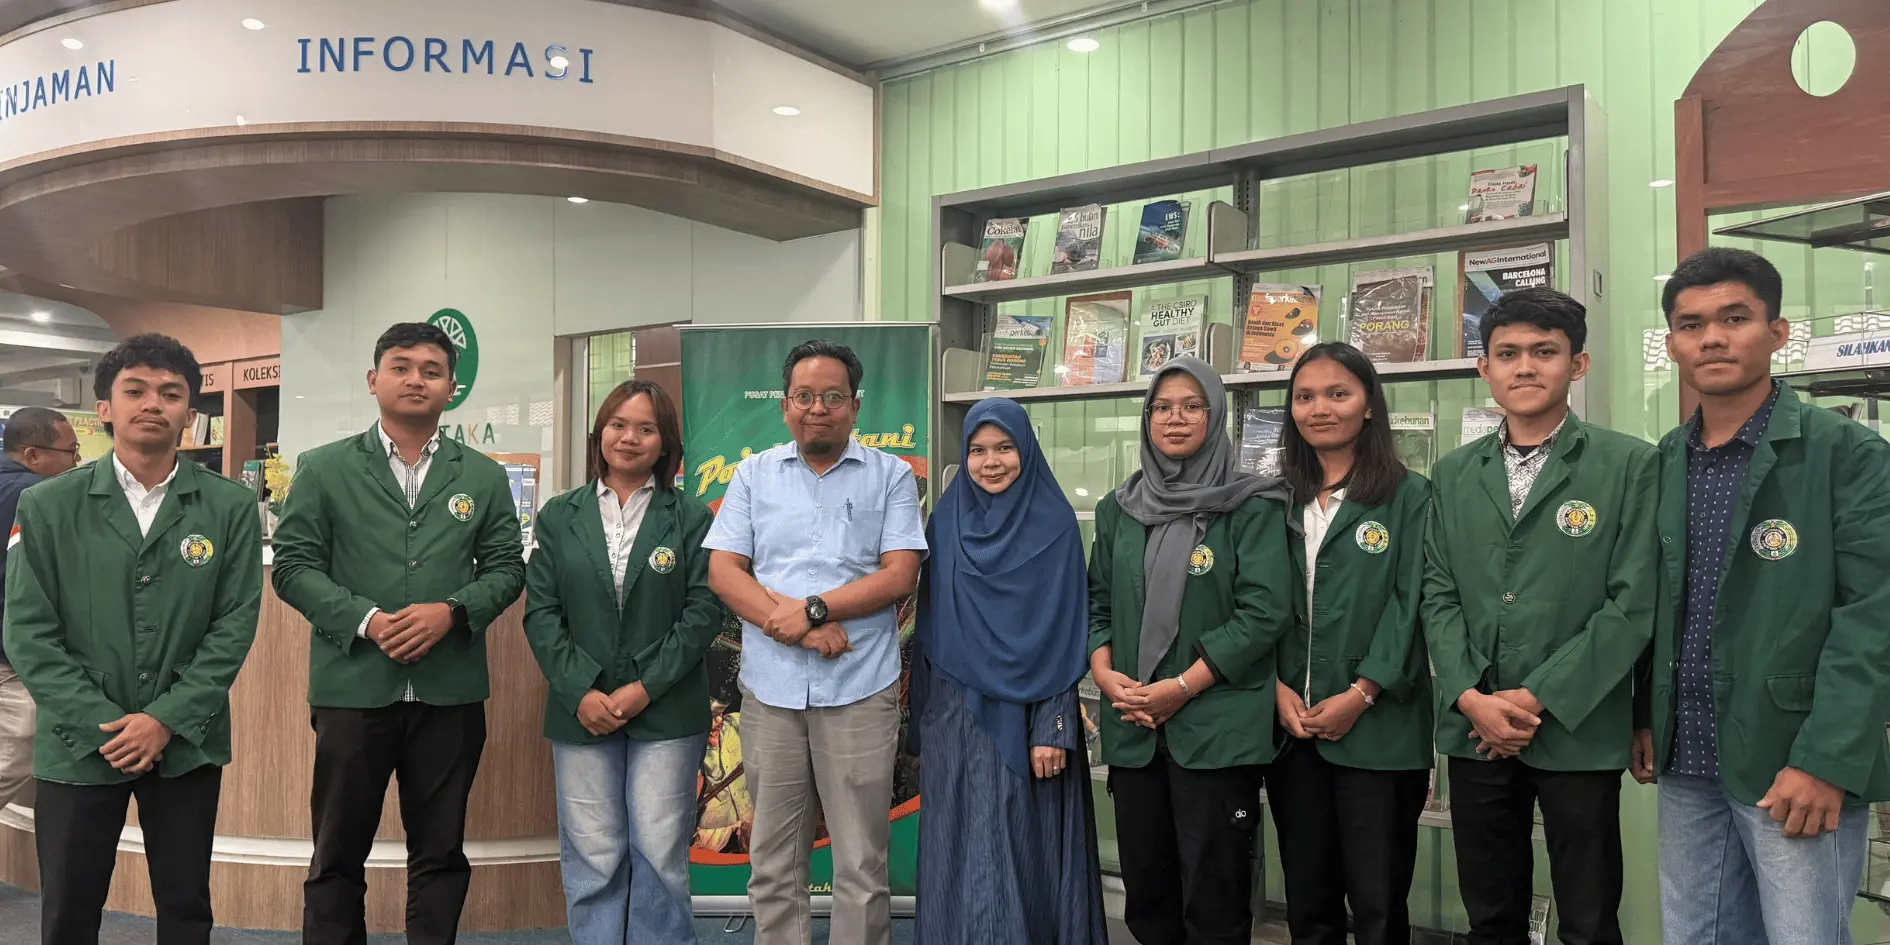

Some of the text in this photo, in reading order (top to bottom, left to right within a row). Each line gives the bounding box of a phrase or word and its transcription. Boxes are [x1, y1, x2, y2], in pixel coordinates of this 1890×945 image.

[297, 36, 594, 83] INFORMASI
[987, 225, 1022, 236] Cokelat
[1079, 224, 1098, 238] nila
[1502, 268, 1546, 280] BARCELONA
[1515, 277, 1546, 287] CALLING
[1173, 300, 1197, 309] CSIRO
[1151, 308, 1195, 320] HEALTHY
[1153, 317, 1190, 327] GUT DIET
[1360, 320, 1410, 331] PORANG
